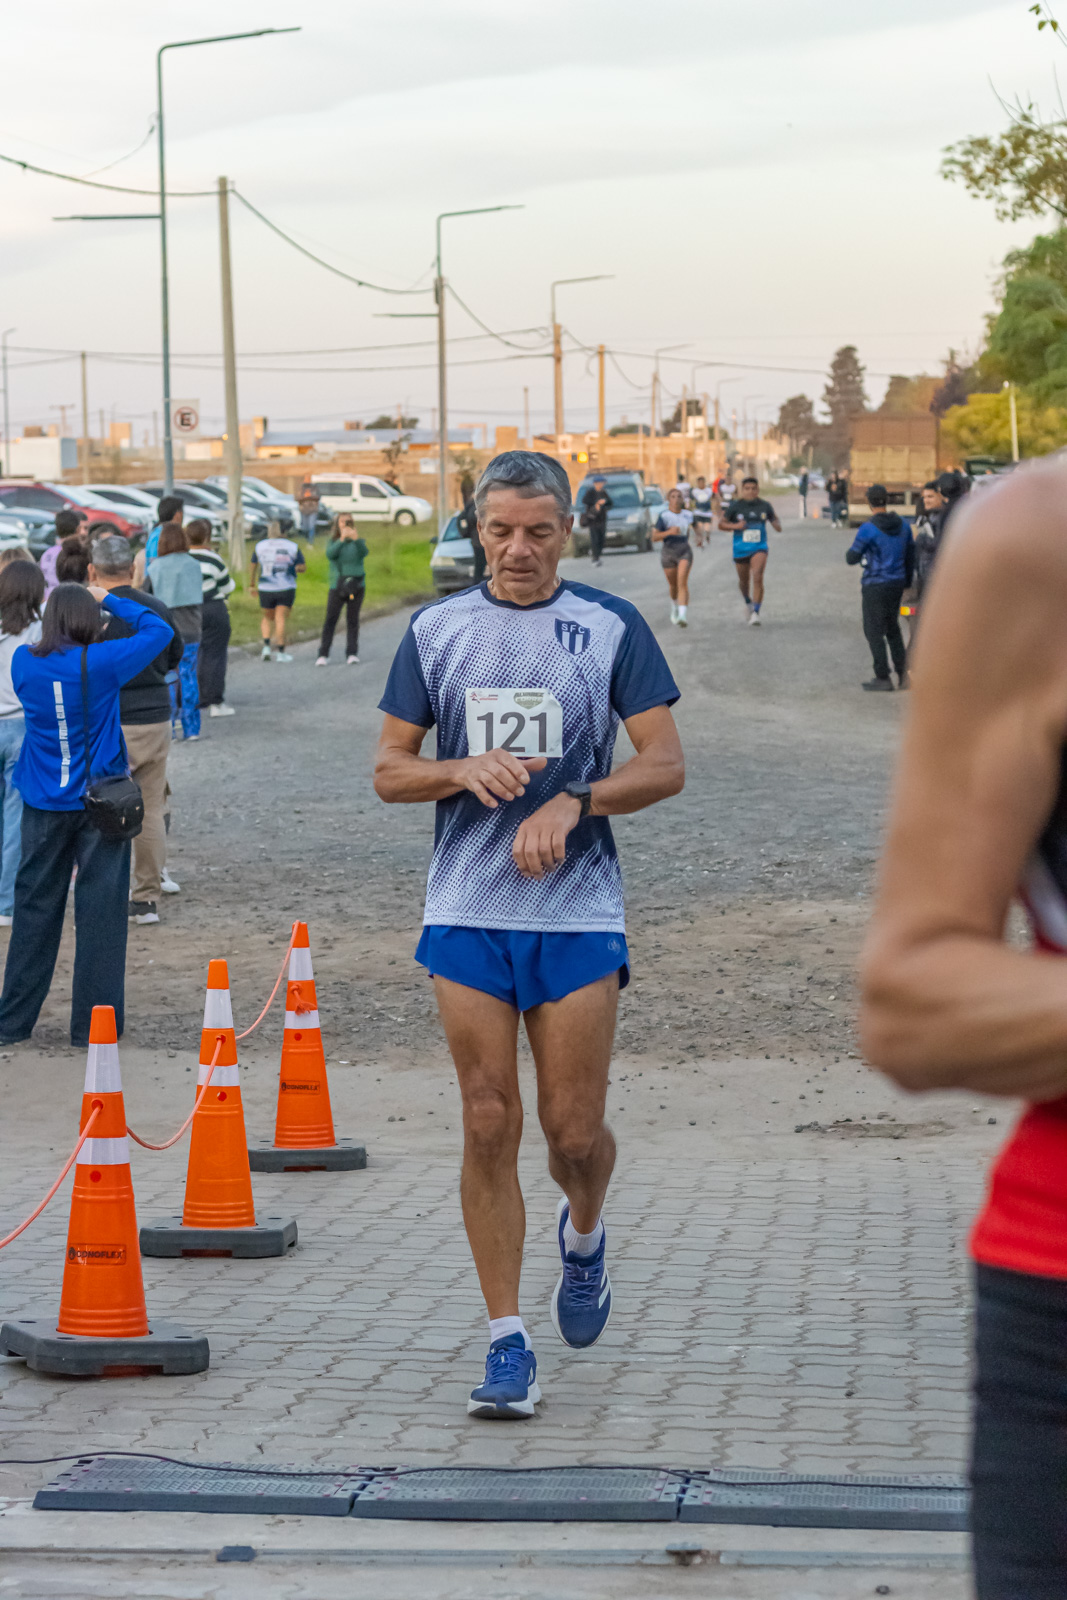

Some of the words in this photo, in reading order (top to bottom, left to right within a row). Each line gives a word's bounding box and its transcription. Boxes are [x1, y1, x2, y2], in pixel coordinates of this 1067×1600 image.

[181, 412, 191, 426] E
[561, 623, 585, 634] SFC
[476, 711, 547, 753] 121
[76, 1250, 123, 1259] CONOFLEX
